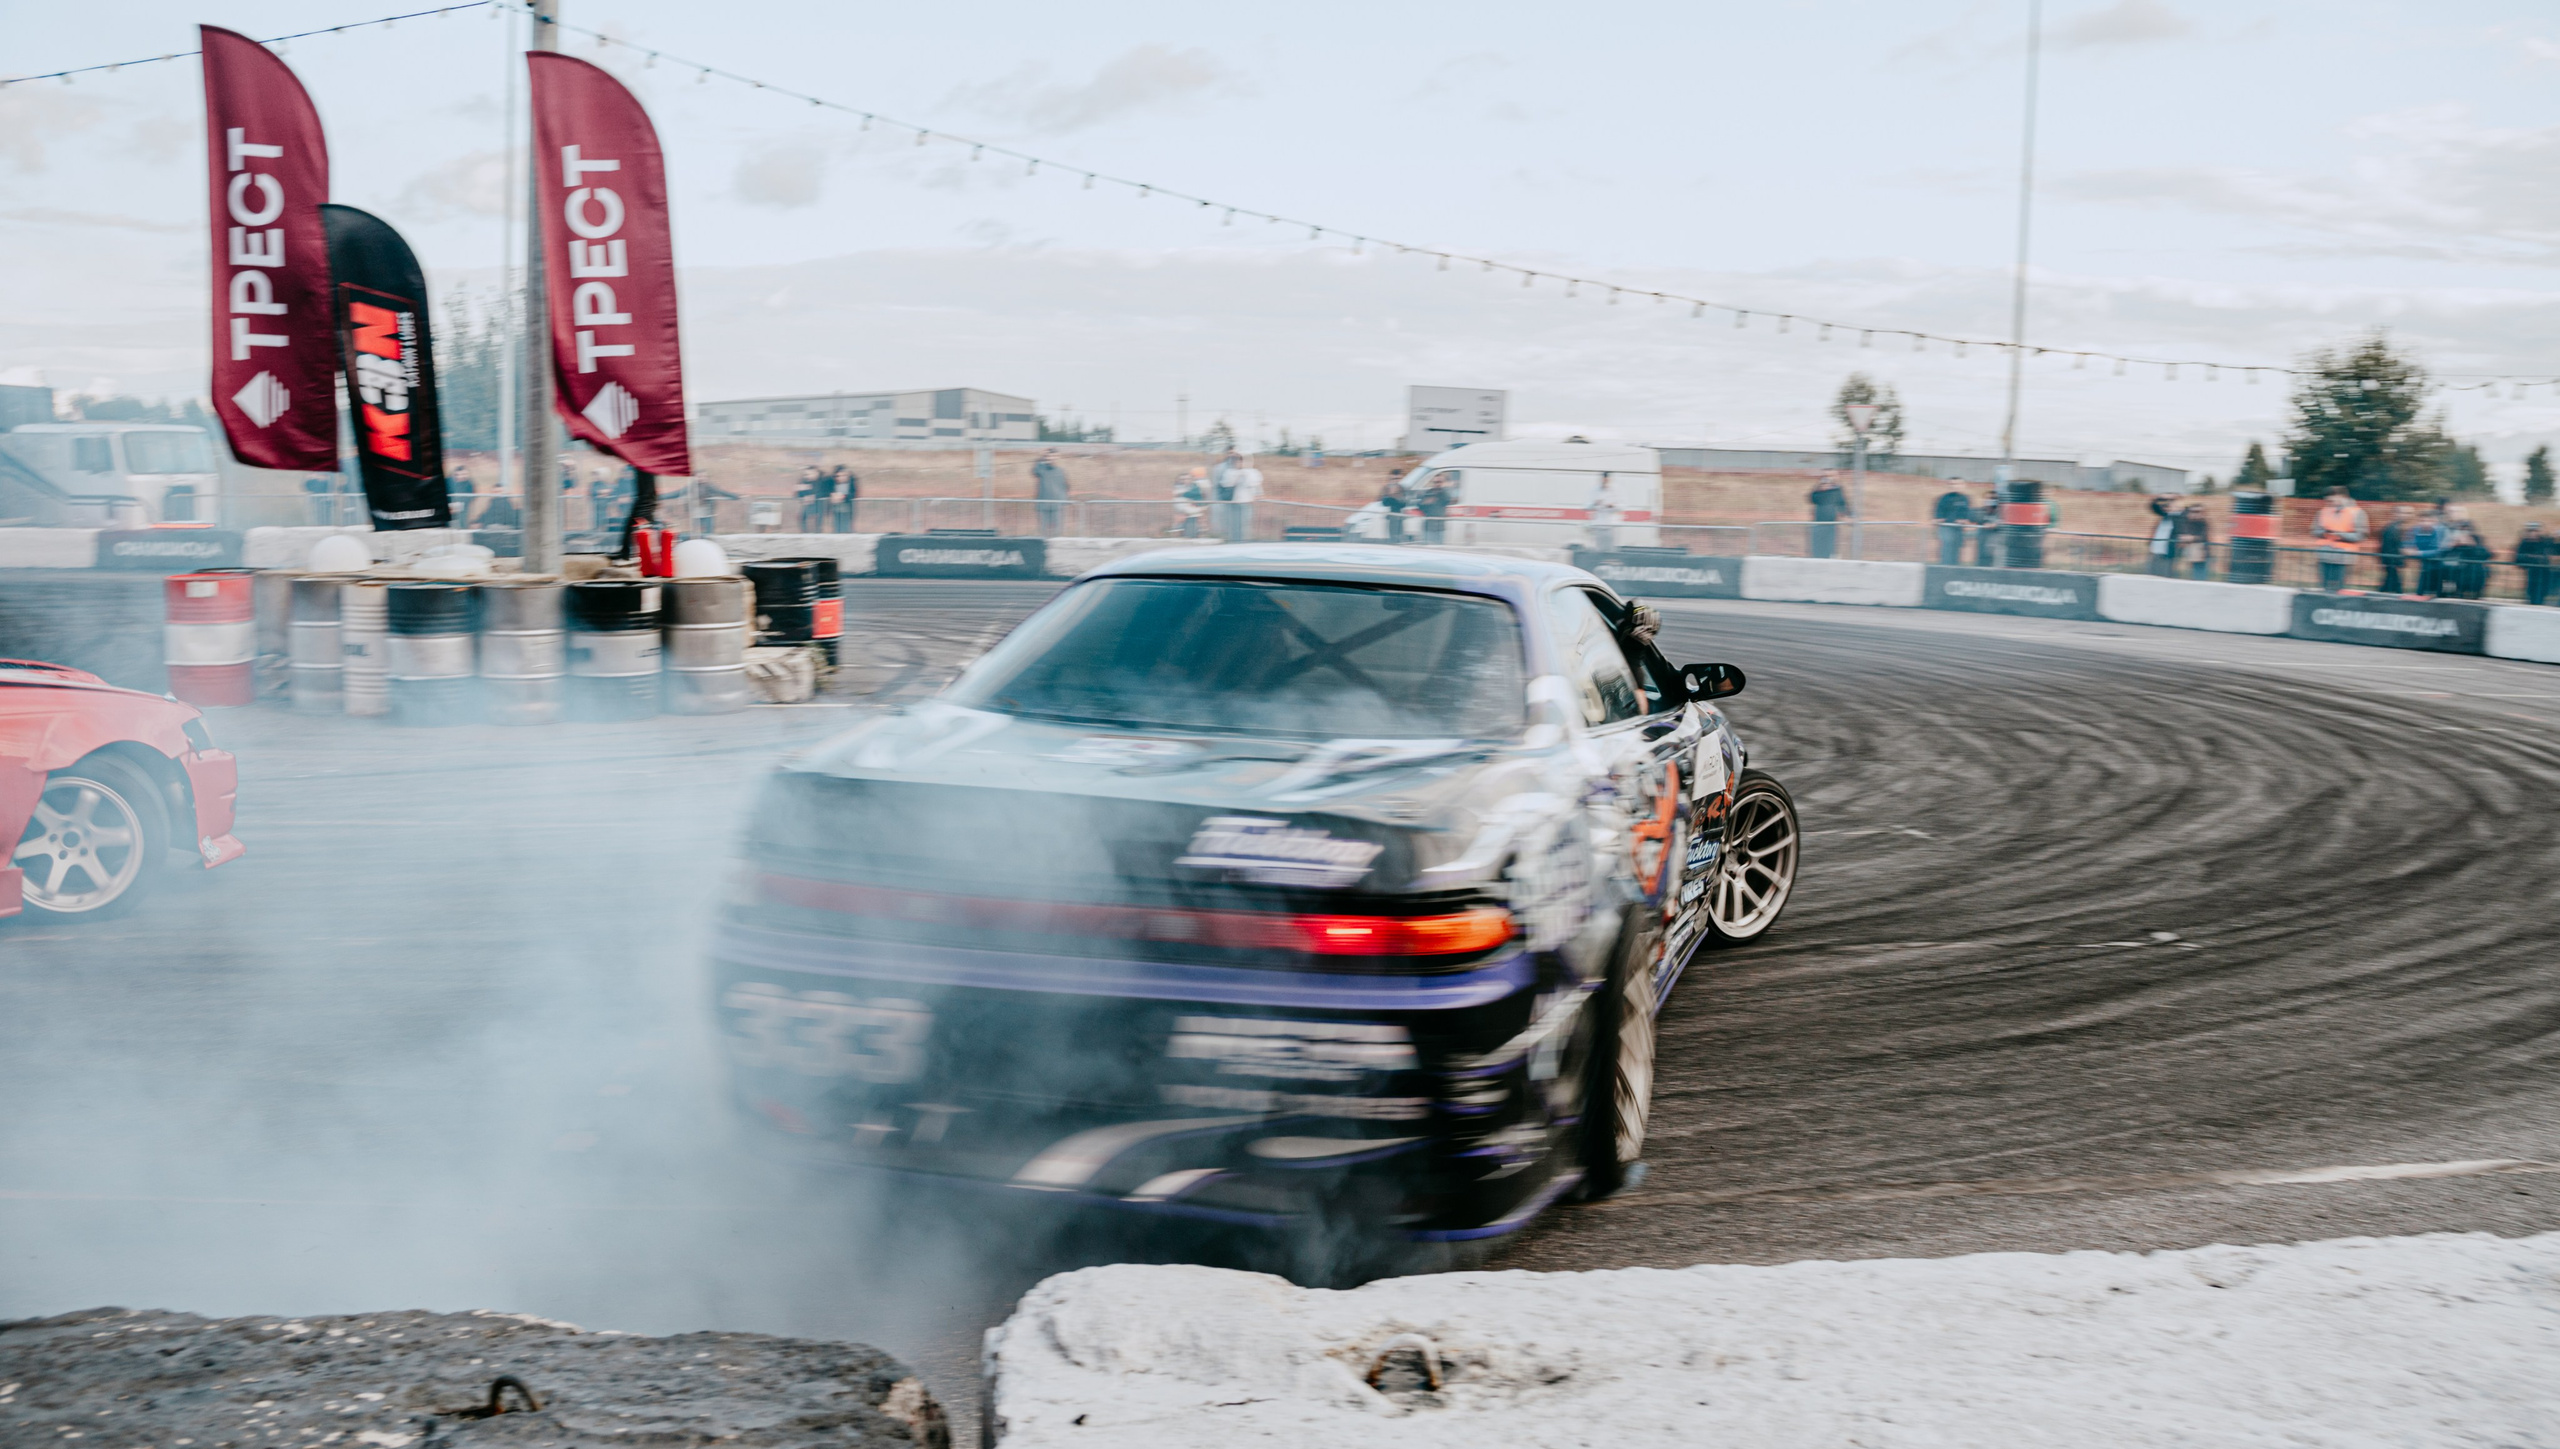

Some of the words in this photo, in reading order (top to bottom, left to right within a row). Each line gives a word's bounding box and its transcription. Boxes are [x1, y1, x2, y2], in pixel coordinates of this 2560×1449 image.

[227, 127, 290, 361] ТРЕСТ
[562, 144, 636, 374] ТРЕСТ
[720, 981, 938, 1084] 333
